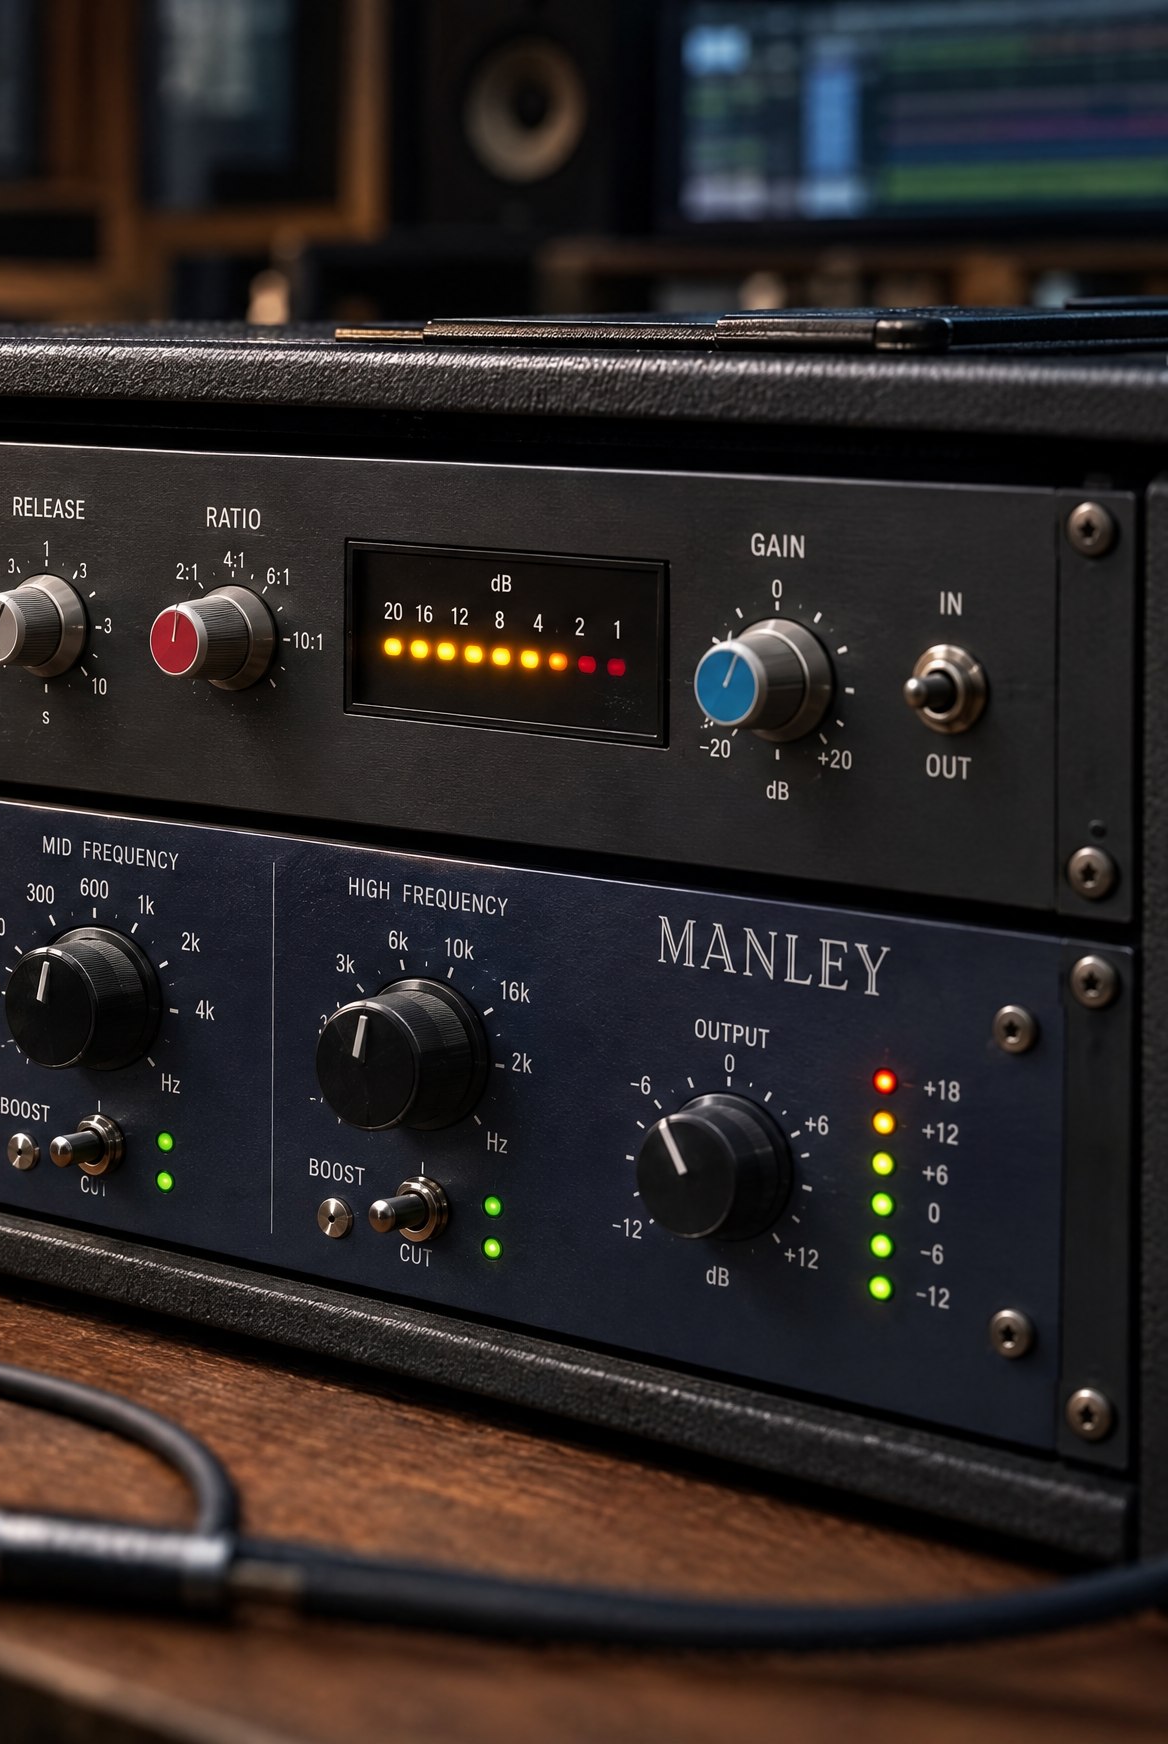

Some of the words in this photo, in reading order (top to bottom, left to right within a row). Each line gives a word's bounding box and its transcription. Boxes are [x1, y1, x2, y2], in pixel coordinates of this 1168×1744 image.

[13, 497, 85, 519] RELEASE
[207, 507, 260, 529] RATIO
[44, 541, 48, 556] 1
[751, 533, 804, 558] GAIN
[224, 551, 243, 568] 4:1
[80, 563, 86, 578] 3
[176, 563, 196, 580] 2:1
[267, 568, 288, 585] 6:1
[491, 574, 511, 592] dB
[772, 580, 782, 598] 0
[940, 592, 962, 615] IN
[385, 602, 402, 620] 20
[416, 605, 432, 622] 16
[452, 607, 468, 625] 12
[495, 611, 504, 629] 8
[534, 614, 543, 632] 4
[576, 618, 584, 636] 2
[614, 621, 619, 639] 1
[92, 678, 106, 695] 10
[43, 711, 49, 724] s
[700, 739, 730, 758] -20
[818, 750, 851, 769] +20
[926, 754, 971, 779] OUT
[767, 781, 789, 800] dB
[43, 836, 71, 855] MID
[84, 841, 178, 870] FREQUENCY
[27, 883, 54, 904] 300
[81, 878, 108, 899] 600
[349, 877, 389, 899] HIGH
[404, 884, 508, 916] FREQUENCY
[138, 895, 154, 915] 1k
[182, 932, 200, 952] 2k
[389, 930, 408, 951] 6k
[445, 938, 473, 960] 10k
[336, 954, 355, 973] 3k
[658, 914, 890, 996] MANLEY
[501, 981, 530, 1003] 16k
[196, 1000, 214, 1020] 4k
[695, 1019, 769, 1048] OUTPUT
[512, 1053, 532, 1073] 2k
[725, 1054, 734, 1072] 0
[162, 1073, 180, 1093] Hz
[631, 1076, 650, 1094] -6
[924, 1080, 960, 1102] +18
[1, 1097, 50, 1122] BOOST
[805, 1115, 828, 1135] +6
[922, 1122, 958, 1145] +12
[487, 1132, 507, 1153] Hz
[310, 1158, 365, 1185] BOOST
[923, 1165, 948, 1185] +6
[929, 1203, 940, 1223] 0
[613, 1218, 642, 1239] -12
[400, 1244, 432, 1267] CUT
[785, 1247, 818, 1269] +12
[921, 1244, 943, 1264] -6
[706, 1266, 729, 1286] dB
[917, 1286, 949, 1309] -12
